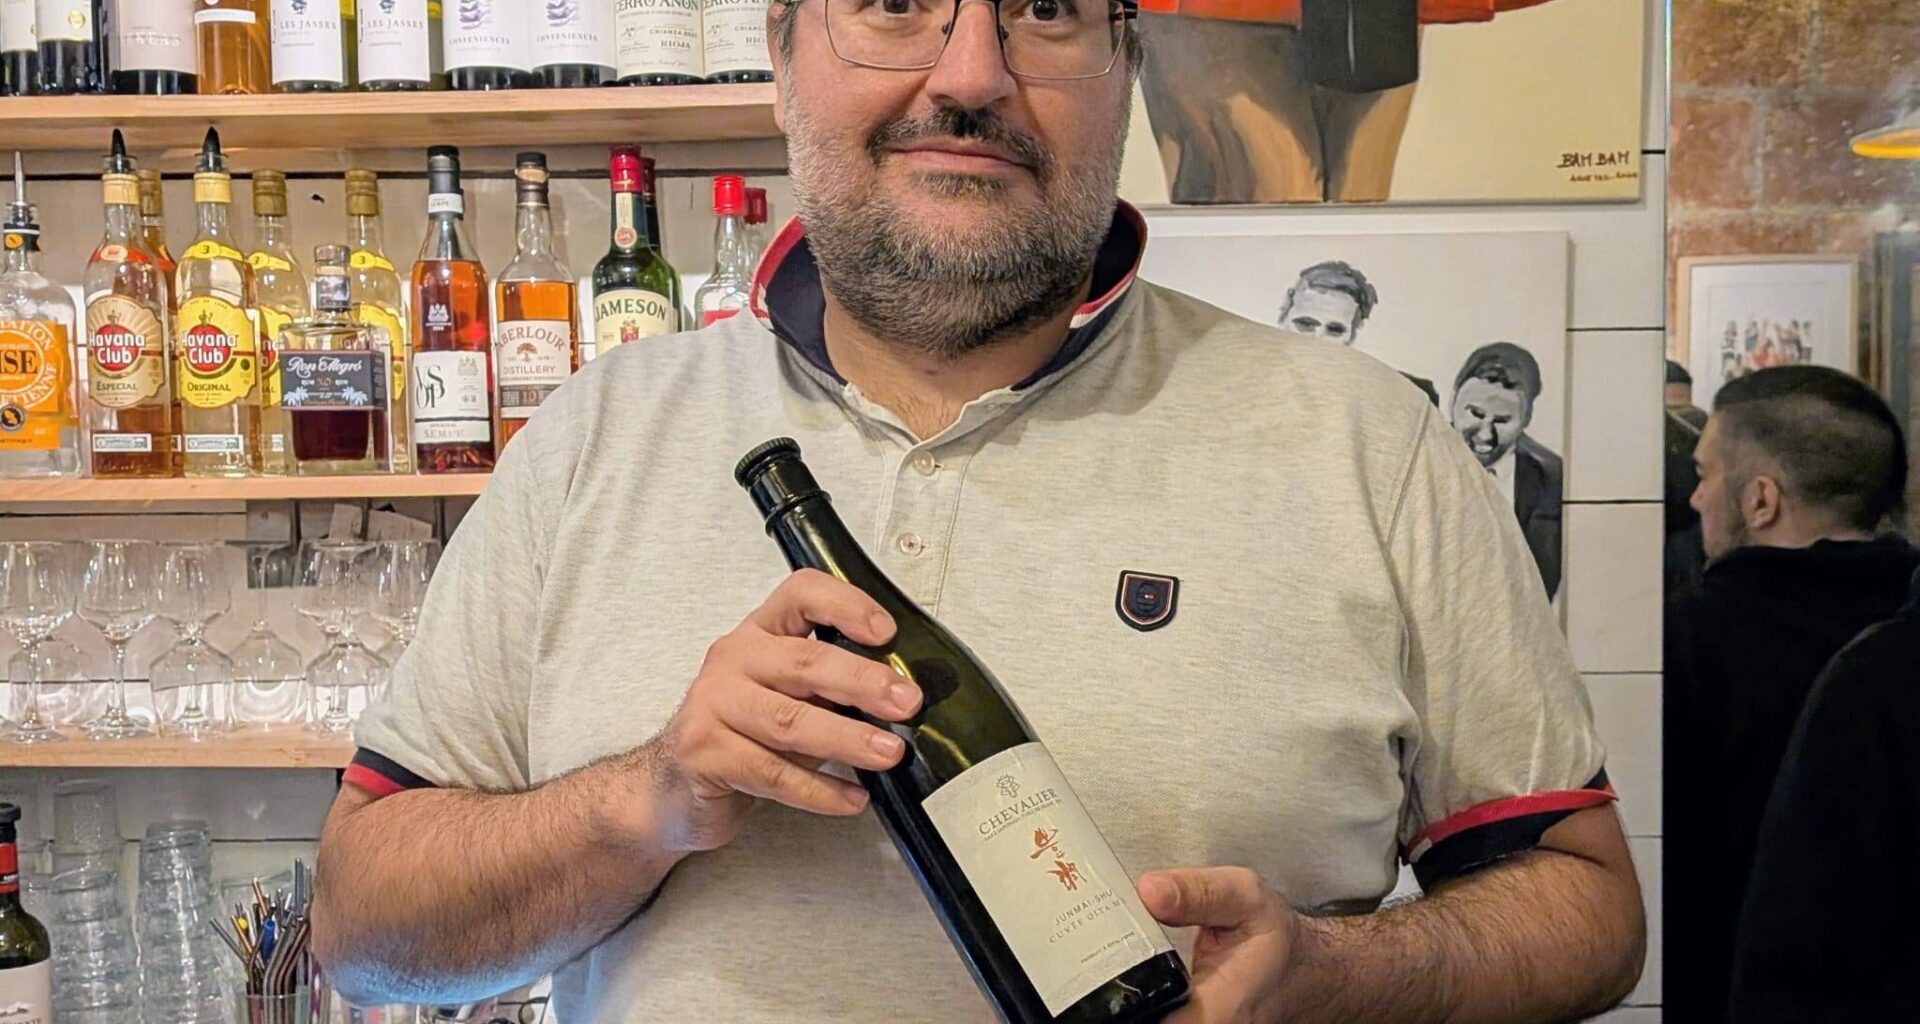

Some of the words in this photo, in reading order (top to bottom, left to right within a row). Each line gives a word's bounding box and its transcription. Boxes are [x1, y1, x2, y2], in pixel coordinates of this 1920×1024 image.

[280, 20, 296, 30] LES
[300, 19, 337, 31] JASSES
[367, 19, 384, 29] LES
[388, 18, 424, 30] JASSES
[649, 28, 682, 36] CRIANZA
[660, 40, 691, 49] RIOJA
[1557, 151, 1592, 169] BAM
[1595, 150, 1630, 166] BAM
[202, 245, 210, 254] 3
[359, 255, 366, 264] 3
[594, 298, 667, 323] JAMESON
[89, 330, 146, 348] Havana
[182, 330, 237, 348] Havana
[97, 346, 133, 365] Club
[189, 346, 225, 365] Club
[286, 355, 317, 379] Ron
[503, 365, 556, 375] DISTILLERY
[522, 390, 538, 401] 10
[978, 787, 1059, 836] CHEVALIER
[1055, 888, 1113, 927] JUNMAI-SHU
